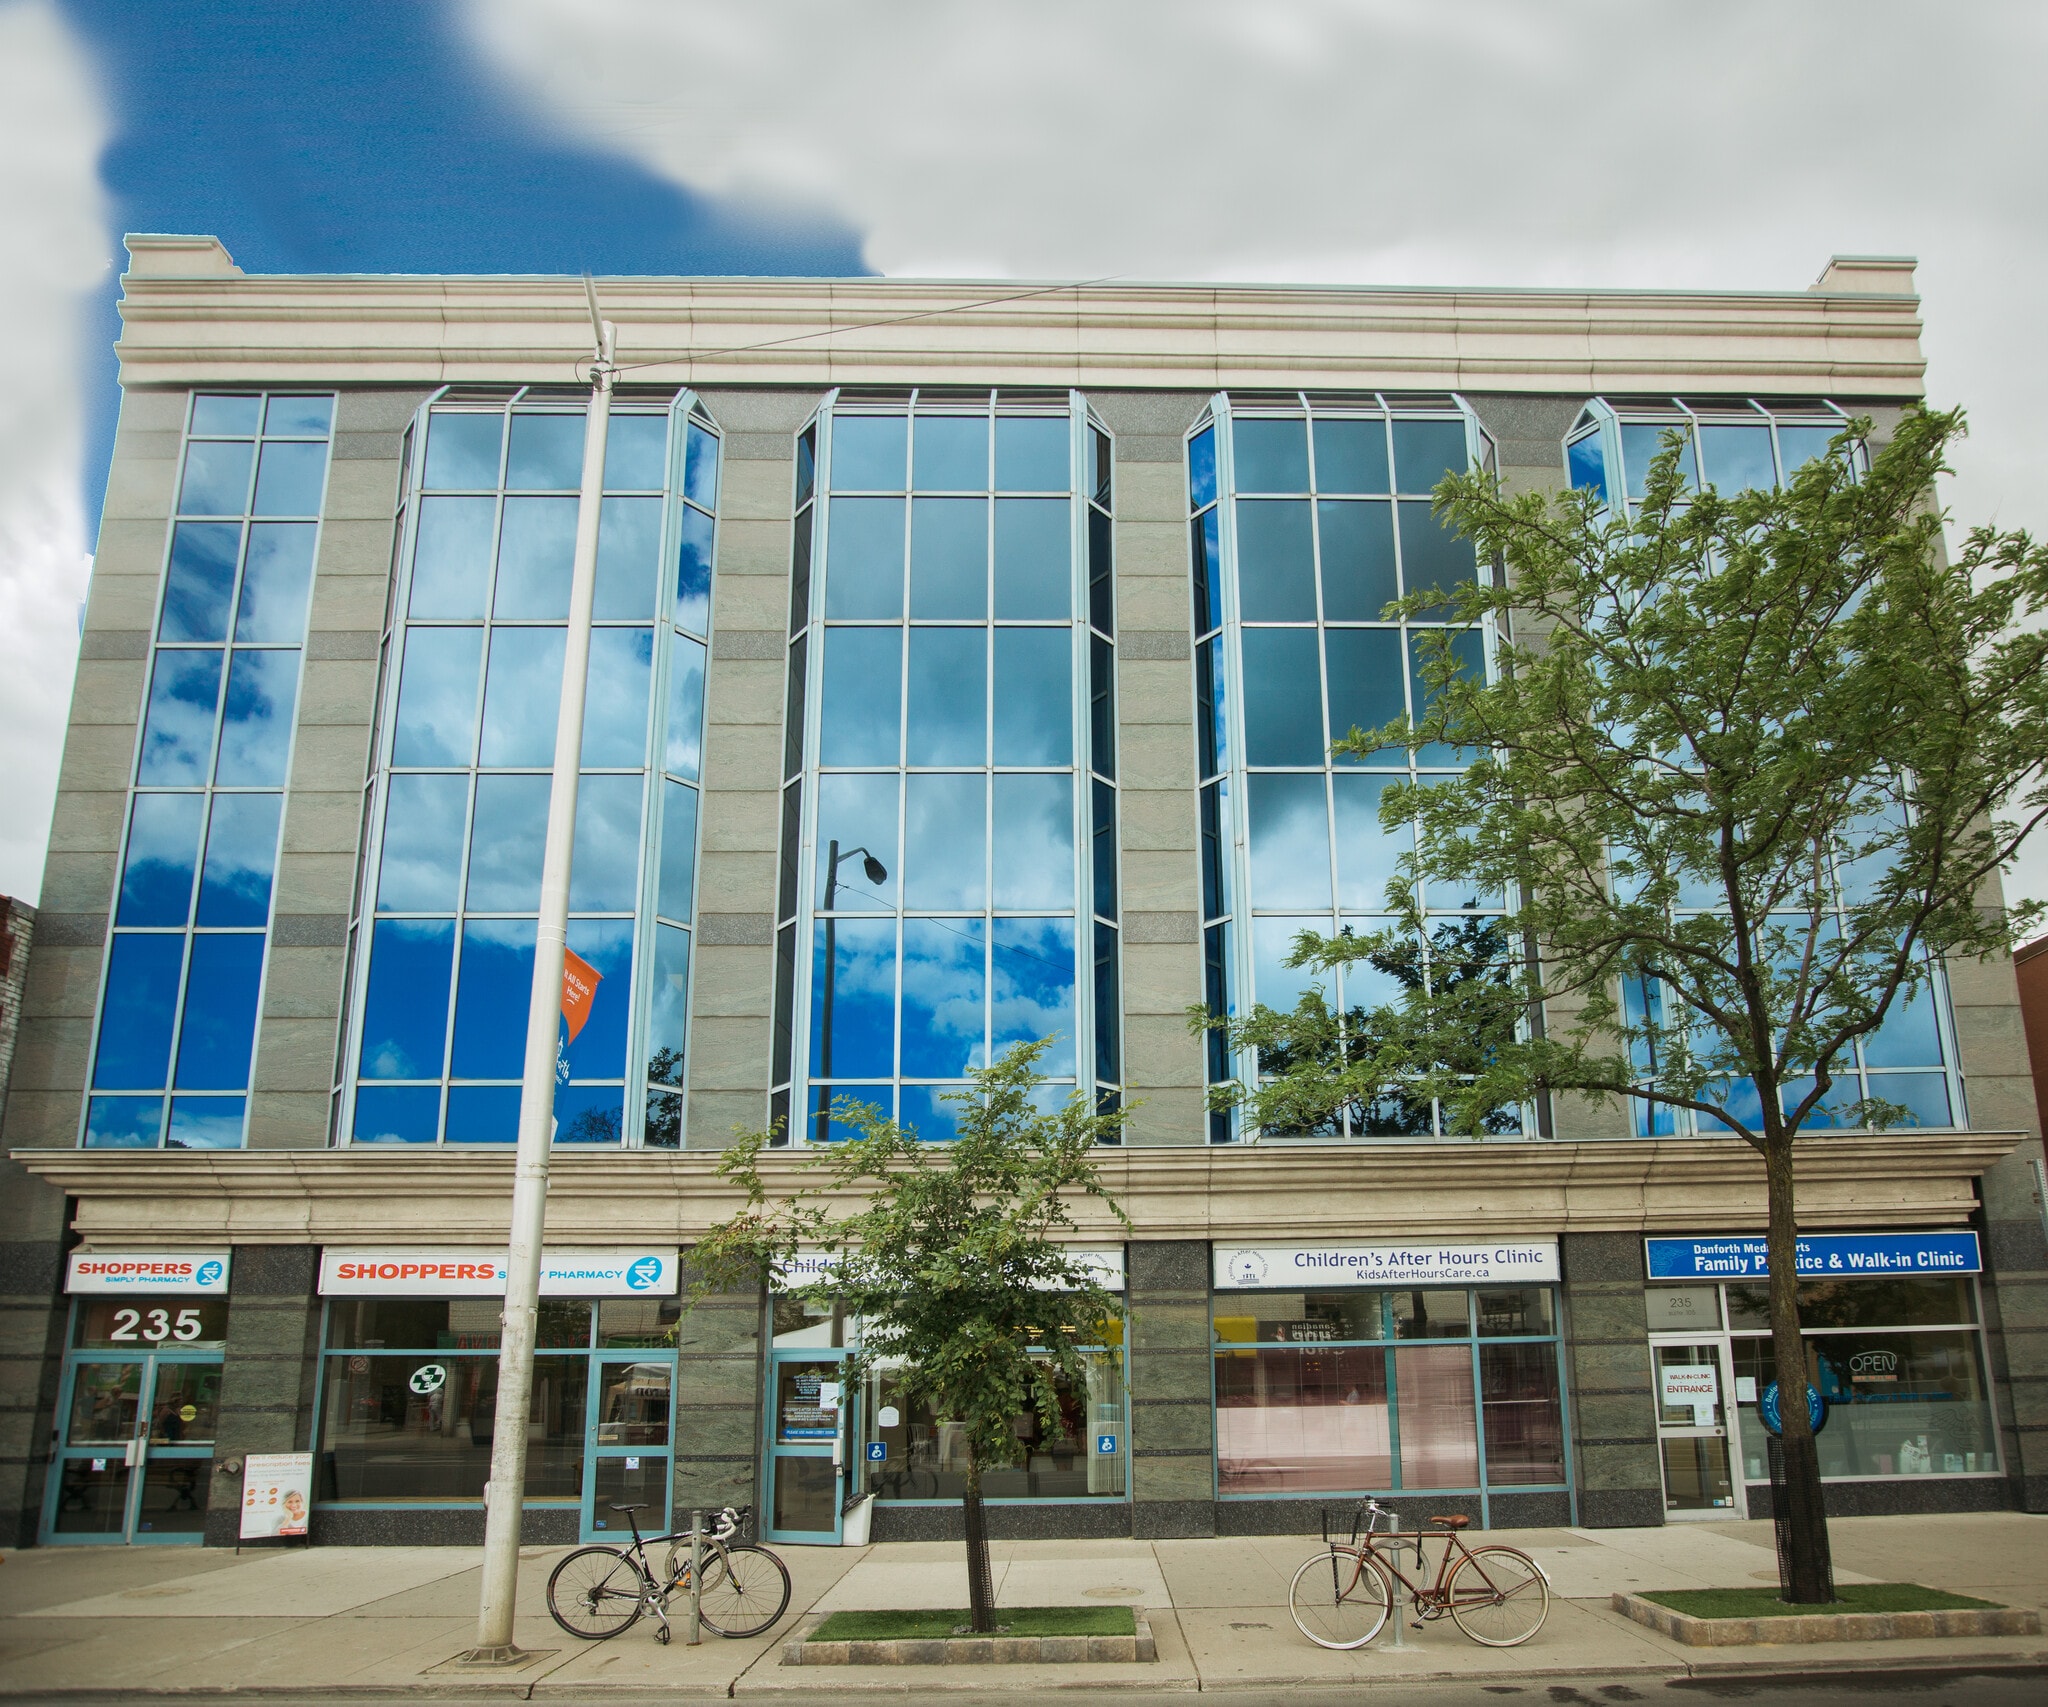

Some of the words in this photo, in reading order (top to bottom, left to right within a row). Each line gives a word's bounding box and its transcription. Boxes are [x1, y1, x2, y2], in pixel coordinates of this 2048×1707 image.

[567, 986, 581, 1002] Here!
[575, 979, 590, 996] Starts
[1693, 1243, 1741, 1254] Danforth
[1795, 1242, 1811, 1252] rts
[1295, 1252, 1383, 1267] Children's
[1388, 1252, 1432, 1266] After
[1439, 1251, 1489, 1264] Hours
[1495, 1249, 1543, 1264] Clinic
[1694, 1255, 1748, 1273] Family
[1754, 1254, 1823, 1270] Ptice
[1829, 1253, 1843, 1268] &
[1847, 1252, 1912, 1268] Walk-in
[1917, 1251, 1964, 1266] Clinic
[77, 1263, 192, 1275] SHOPPERS
[337, 1264, 495, 1279] SHOPPERS
[549, 1271, 623, 1279] PHARMACY
[1357, 1268, 1489, 1279] KidsAfterHoursCare.ca
[1670, 1297, 1692, 1307] 235
[110, 1309, 202, 1341] 235
[1849, 1355, 1895, 1372] OPEN
[1667, 1385, 1713, 1393] ENTRANCE
